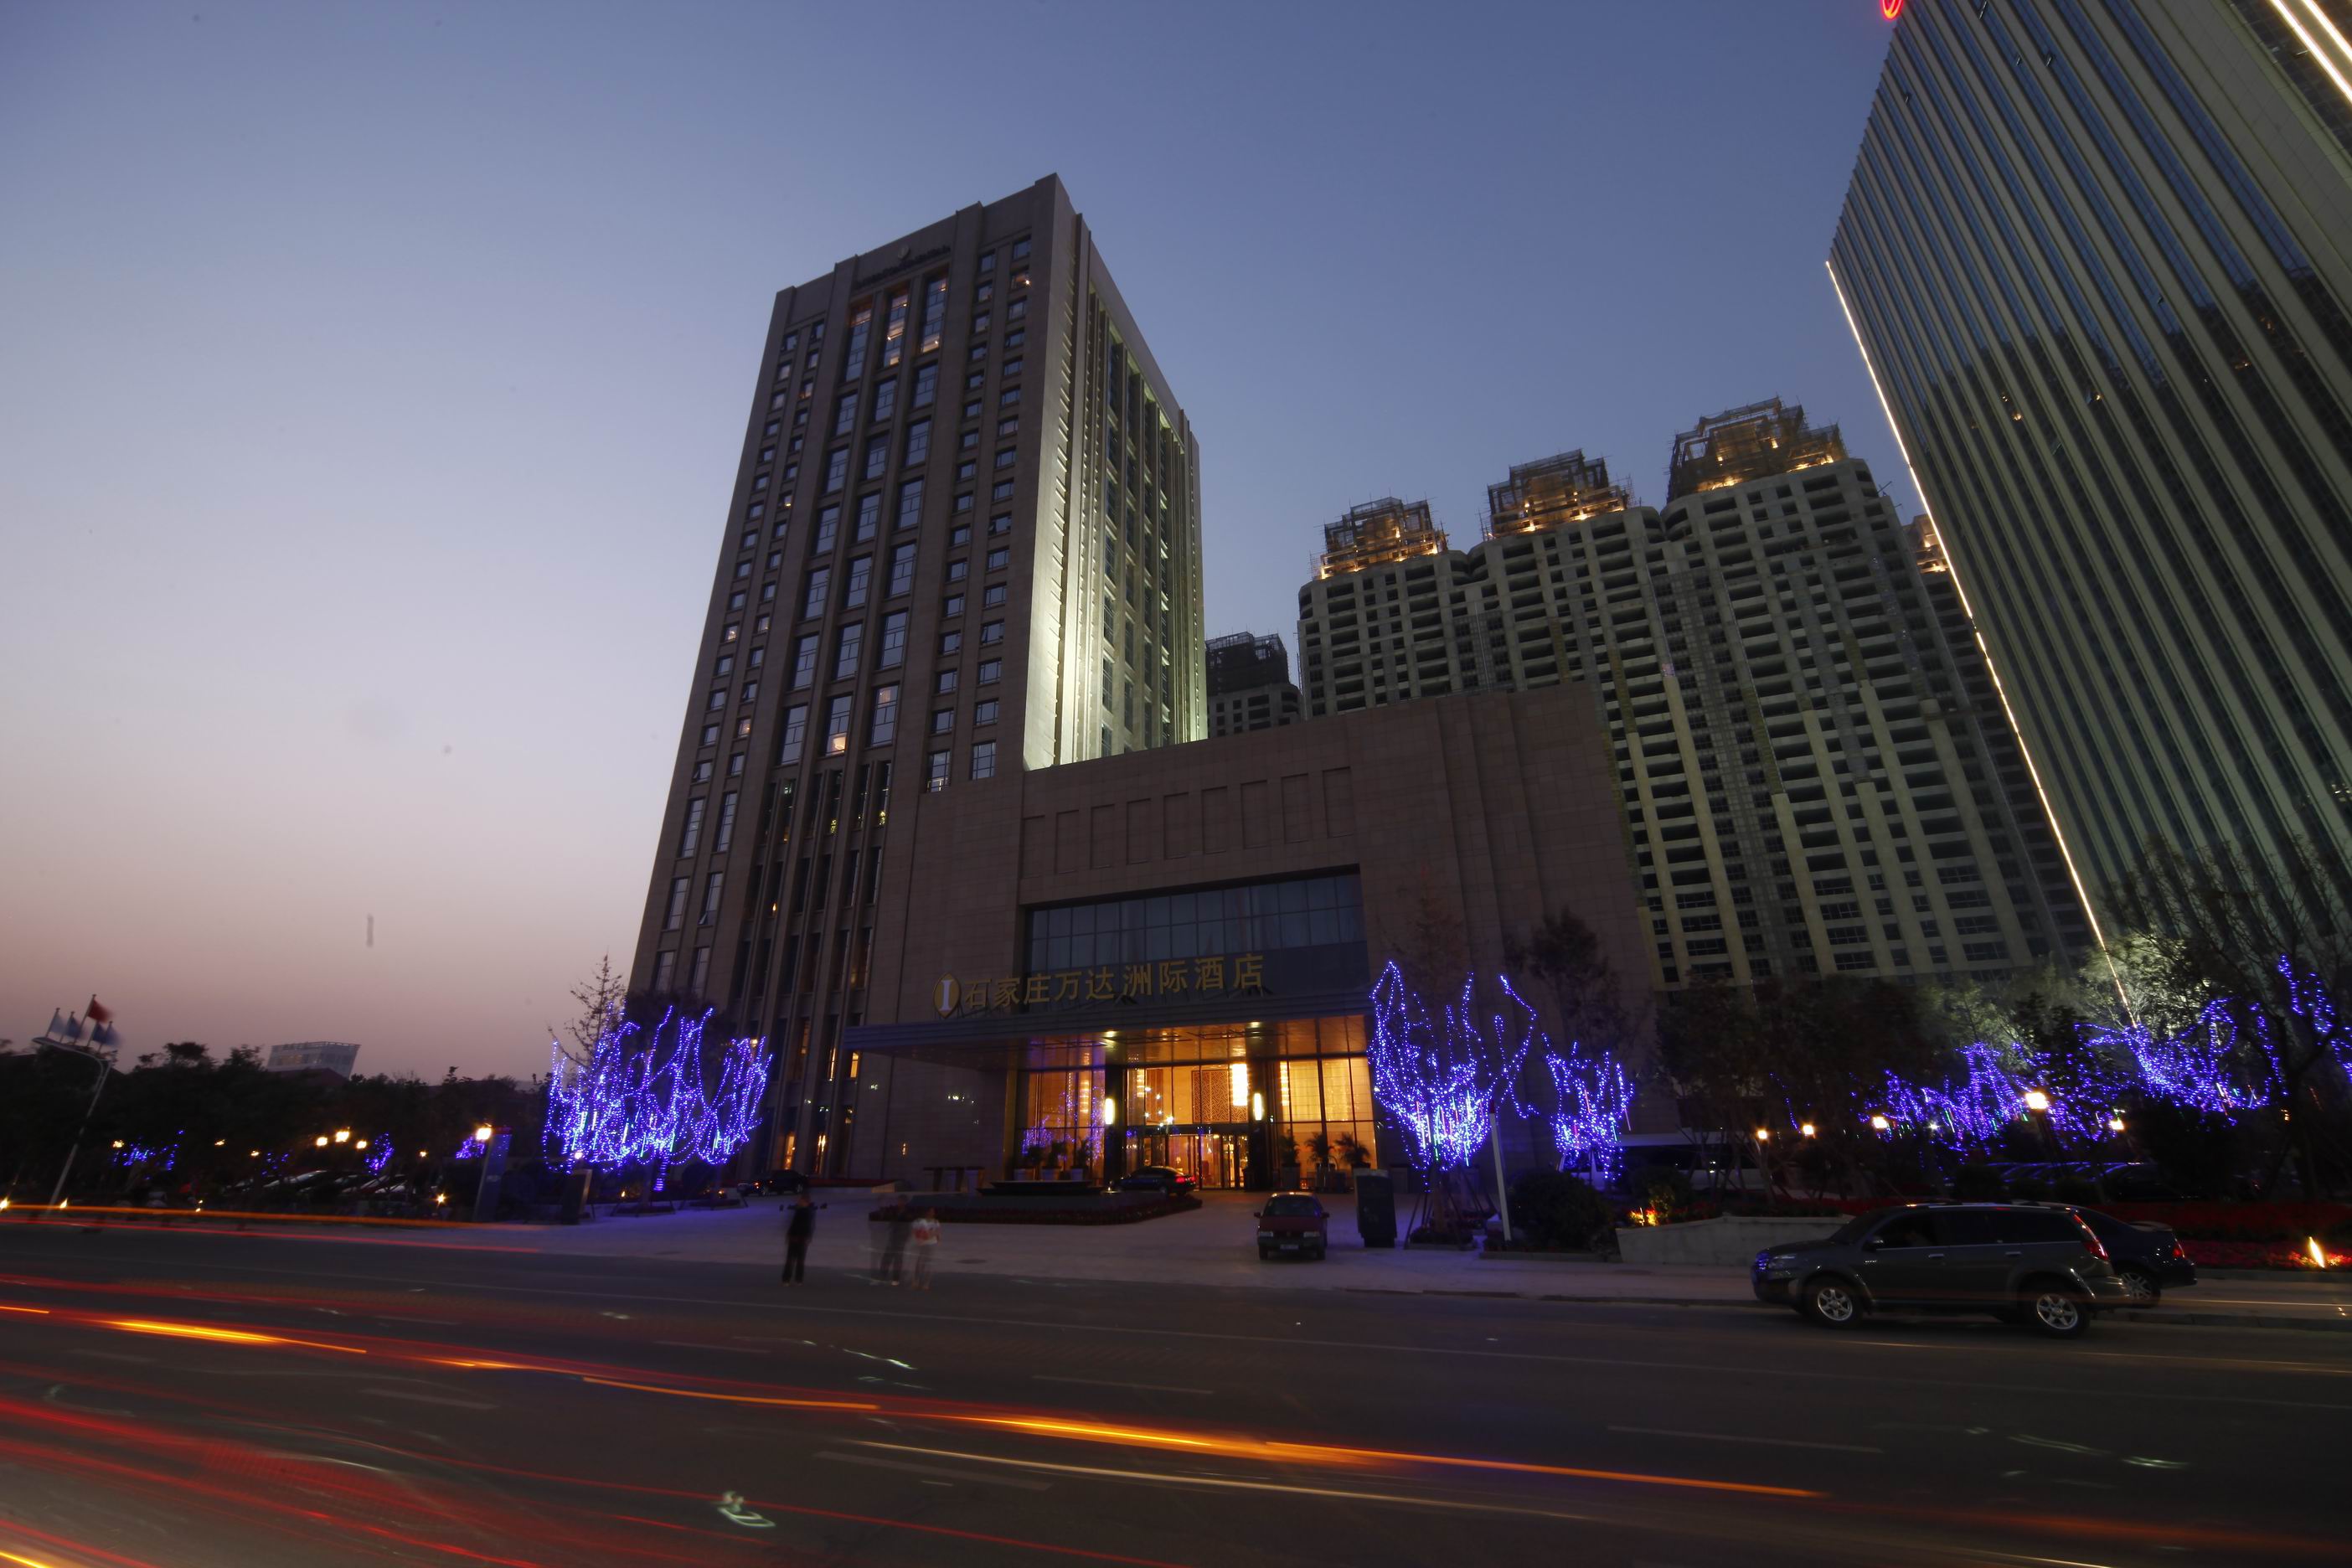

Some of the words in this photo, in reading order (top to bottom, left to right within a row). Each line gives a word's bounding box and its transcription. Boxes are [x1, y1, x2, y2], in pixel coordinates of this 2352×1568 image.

[963, 952, 1265, 1008] 石家庄万达洲际酒店
